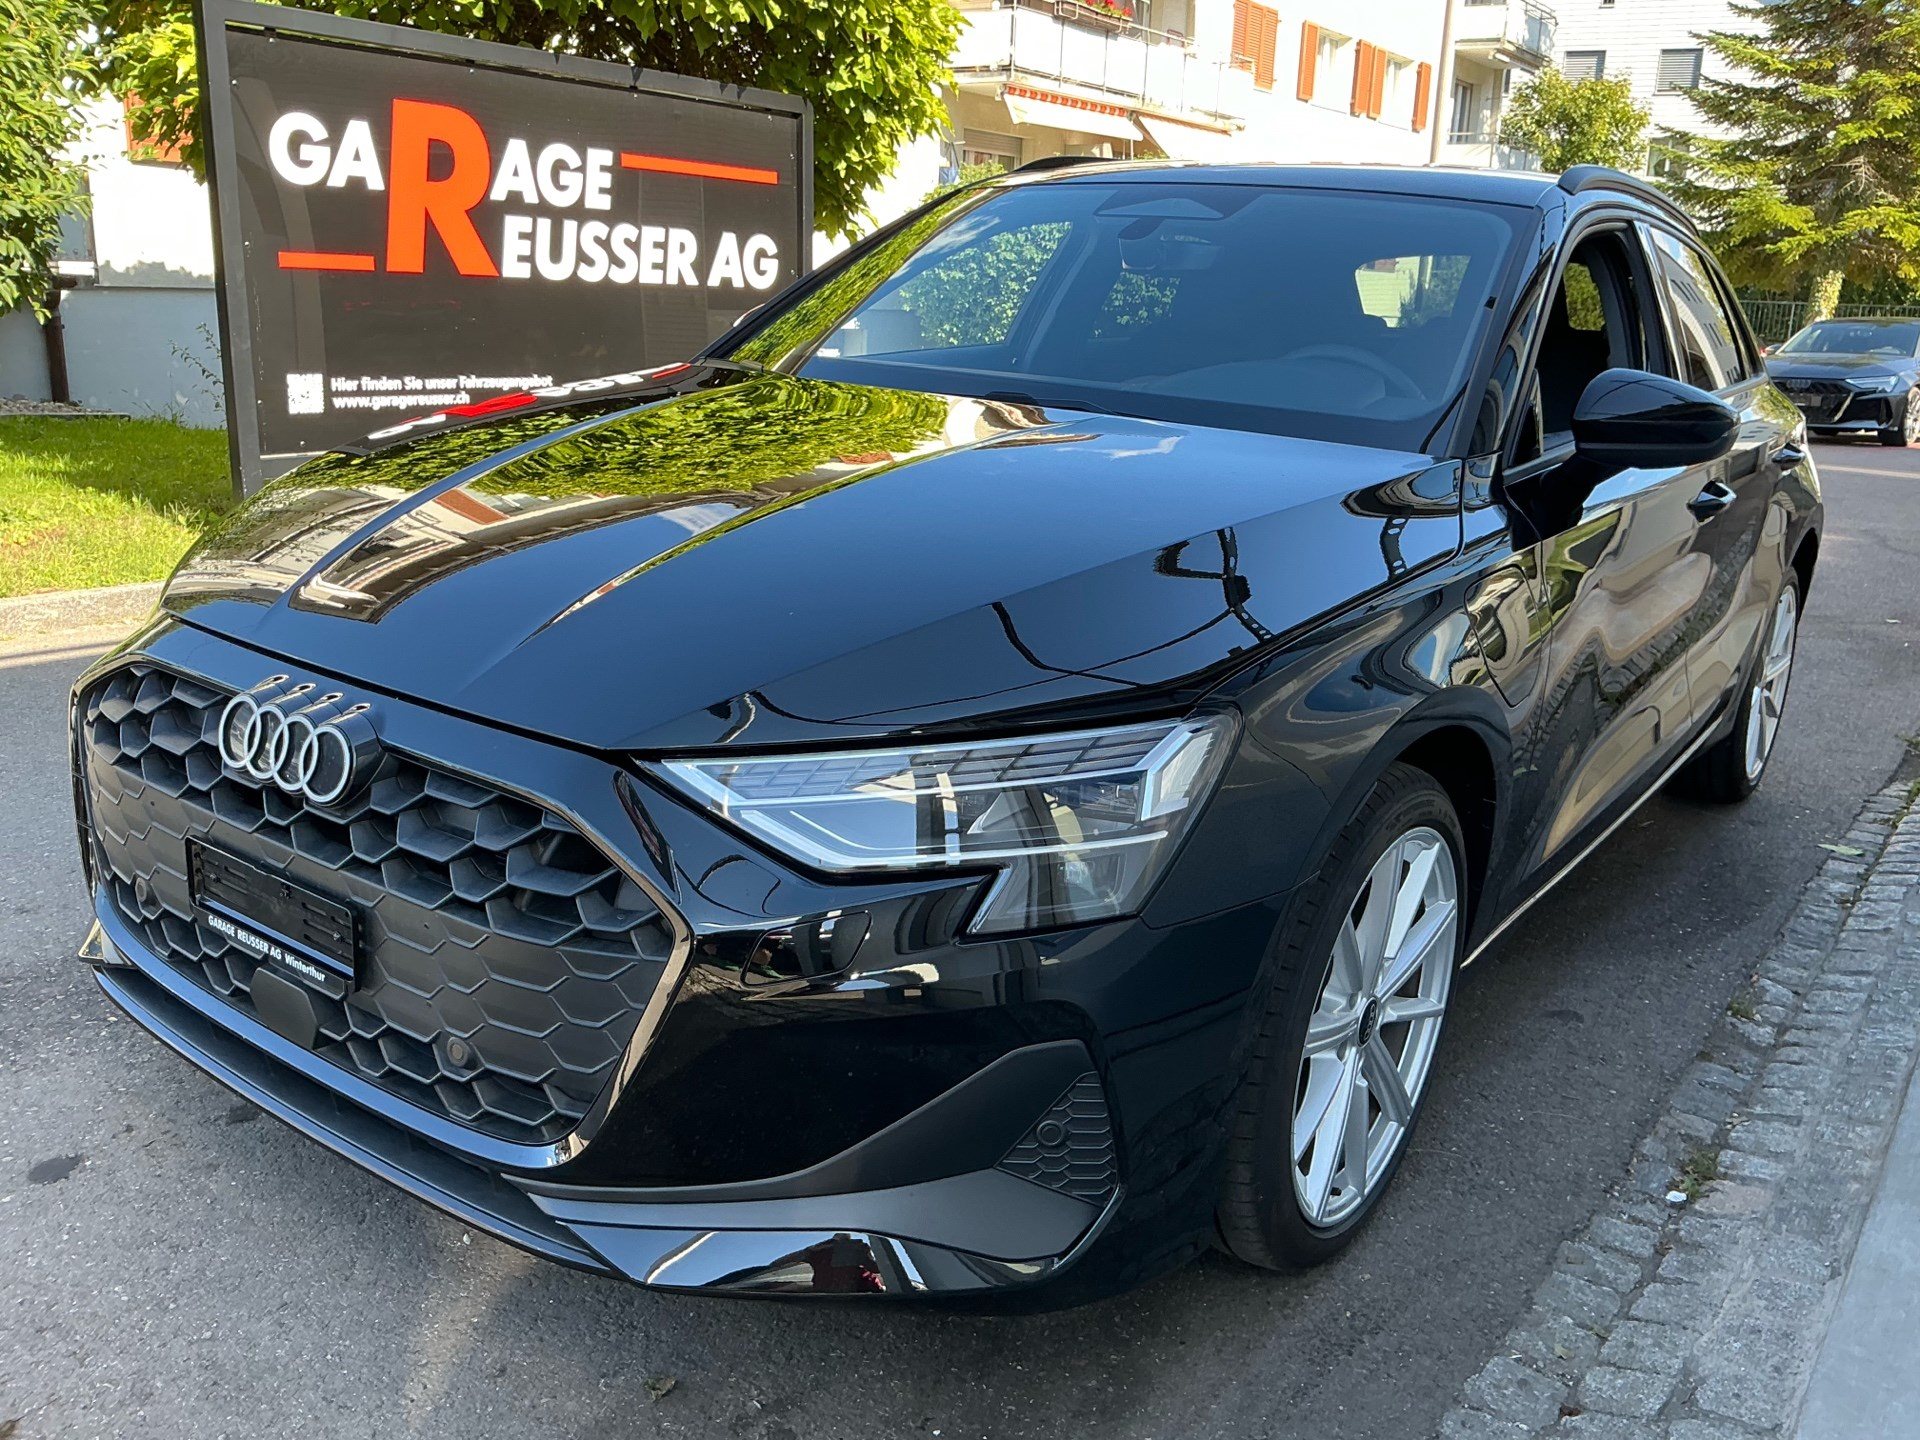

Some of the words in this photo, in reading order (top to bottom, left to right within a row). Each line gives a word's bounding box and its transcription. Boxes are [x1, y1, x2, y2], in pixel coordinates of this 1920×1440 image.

[268, 98, 614, 278] GARAGE
[706, 231, 779, 290] AG
[330, 376, 359, 392] Hier
[360, 375, 403, 391] finden
[403, 375, 424, 391] Sie
[424, 378, 458, 390] unser
[458, 373, 554, 391] Fahrzeugangebot
[331, 391, 471, 410] www.garagereusser.ch
[208, 915, 235, 937] GARAGE
[237, 929, 269, 954] REUSSER
[269, 946, 282, 960] AG
[284, 953, 326, 982] Winterthur
